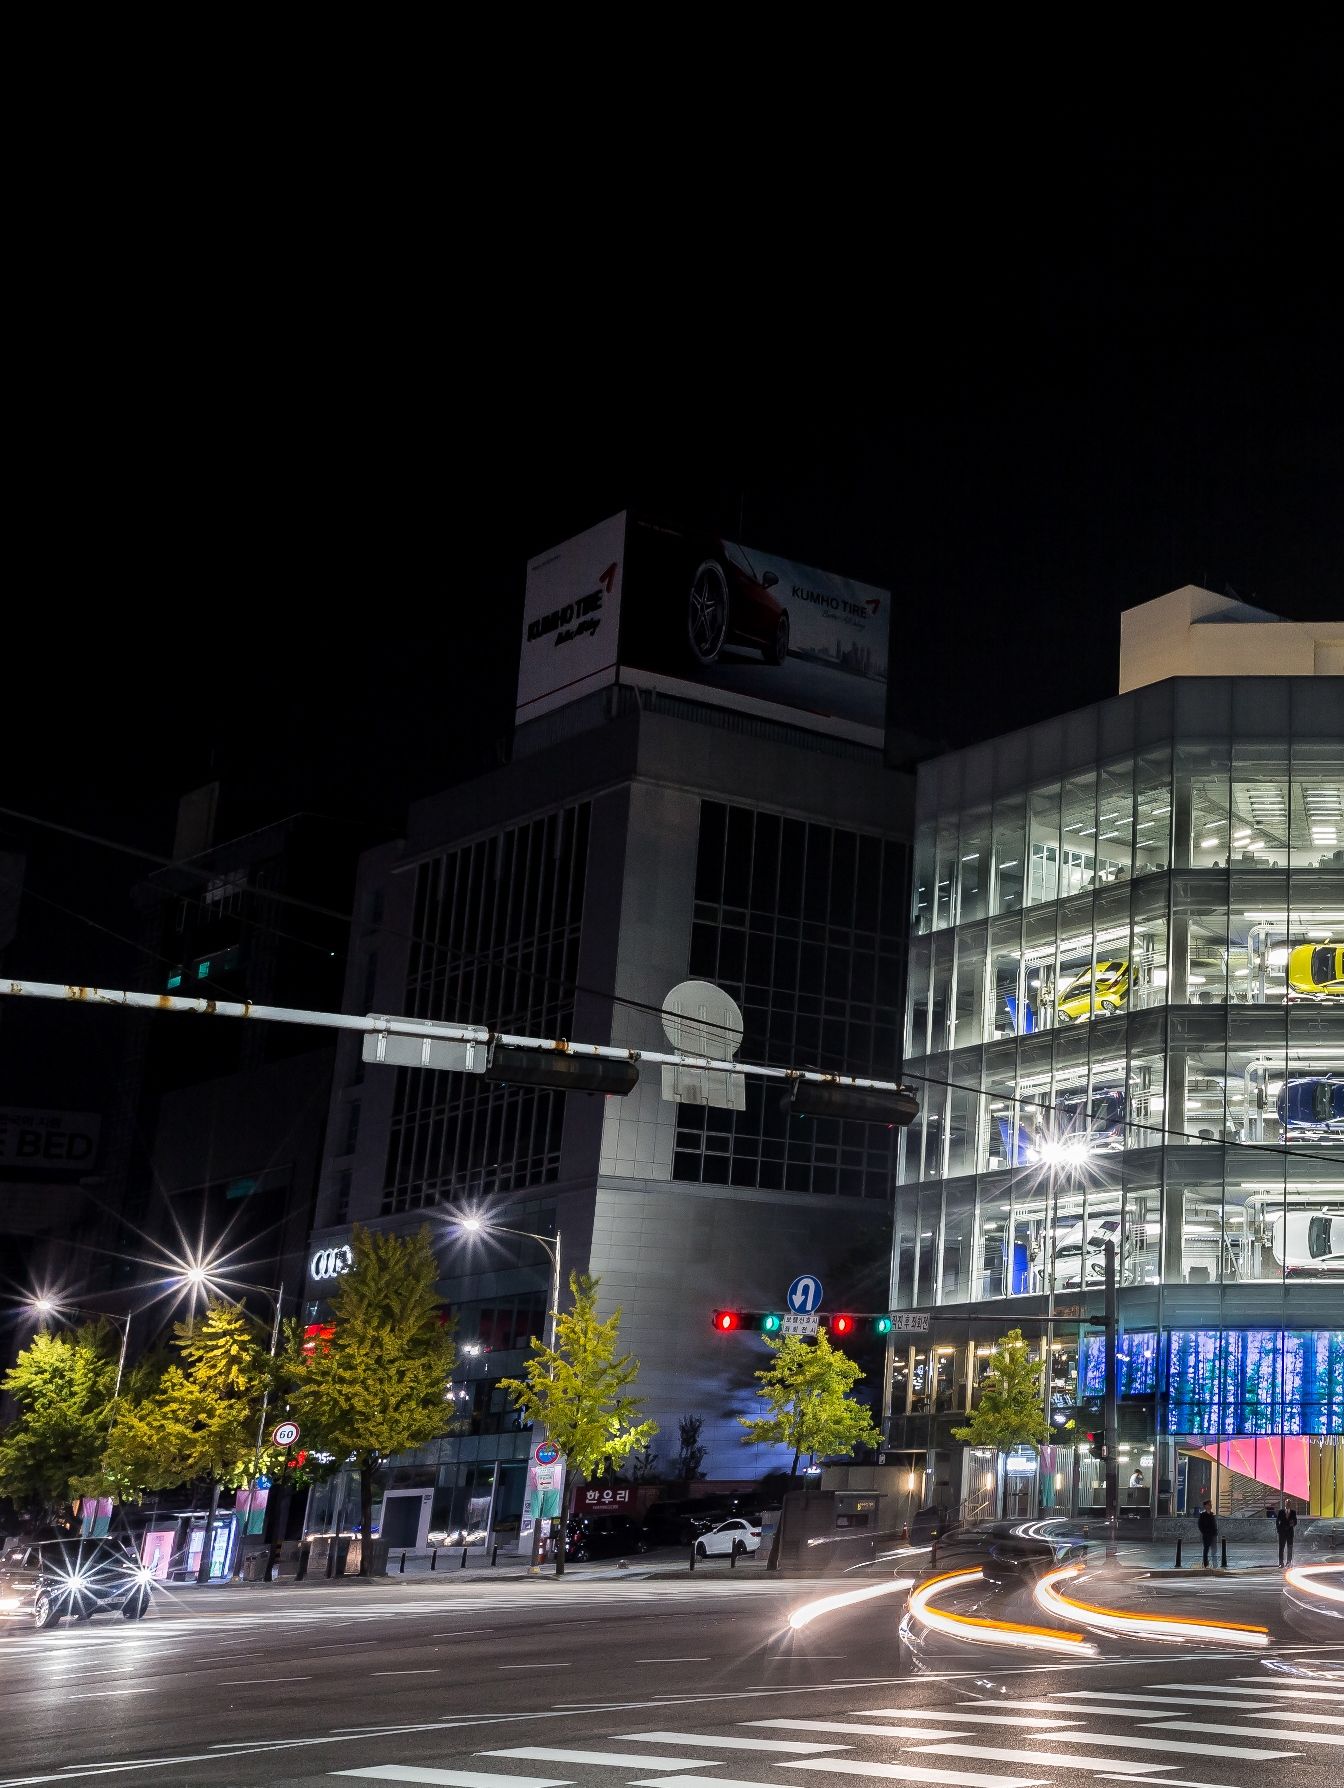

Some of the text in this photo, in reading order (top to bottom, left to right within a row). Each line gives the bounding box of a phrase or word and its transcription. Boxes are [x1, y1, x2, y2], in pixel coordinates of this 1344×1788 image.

[792, 585, 867, 620] KUMHO TIRE
[527, 603, 574, 642] KUMHO
[16, 1129, 93, 1161] BED
[892, 1314, 903, 1330] 직진
[904, 1314, 910, 1330] 후
[279, 1430, 294, 1439] 60
[586, 1489, 630, 1504] 한우리
